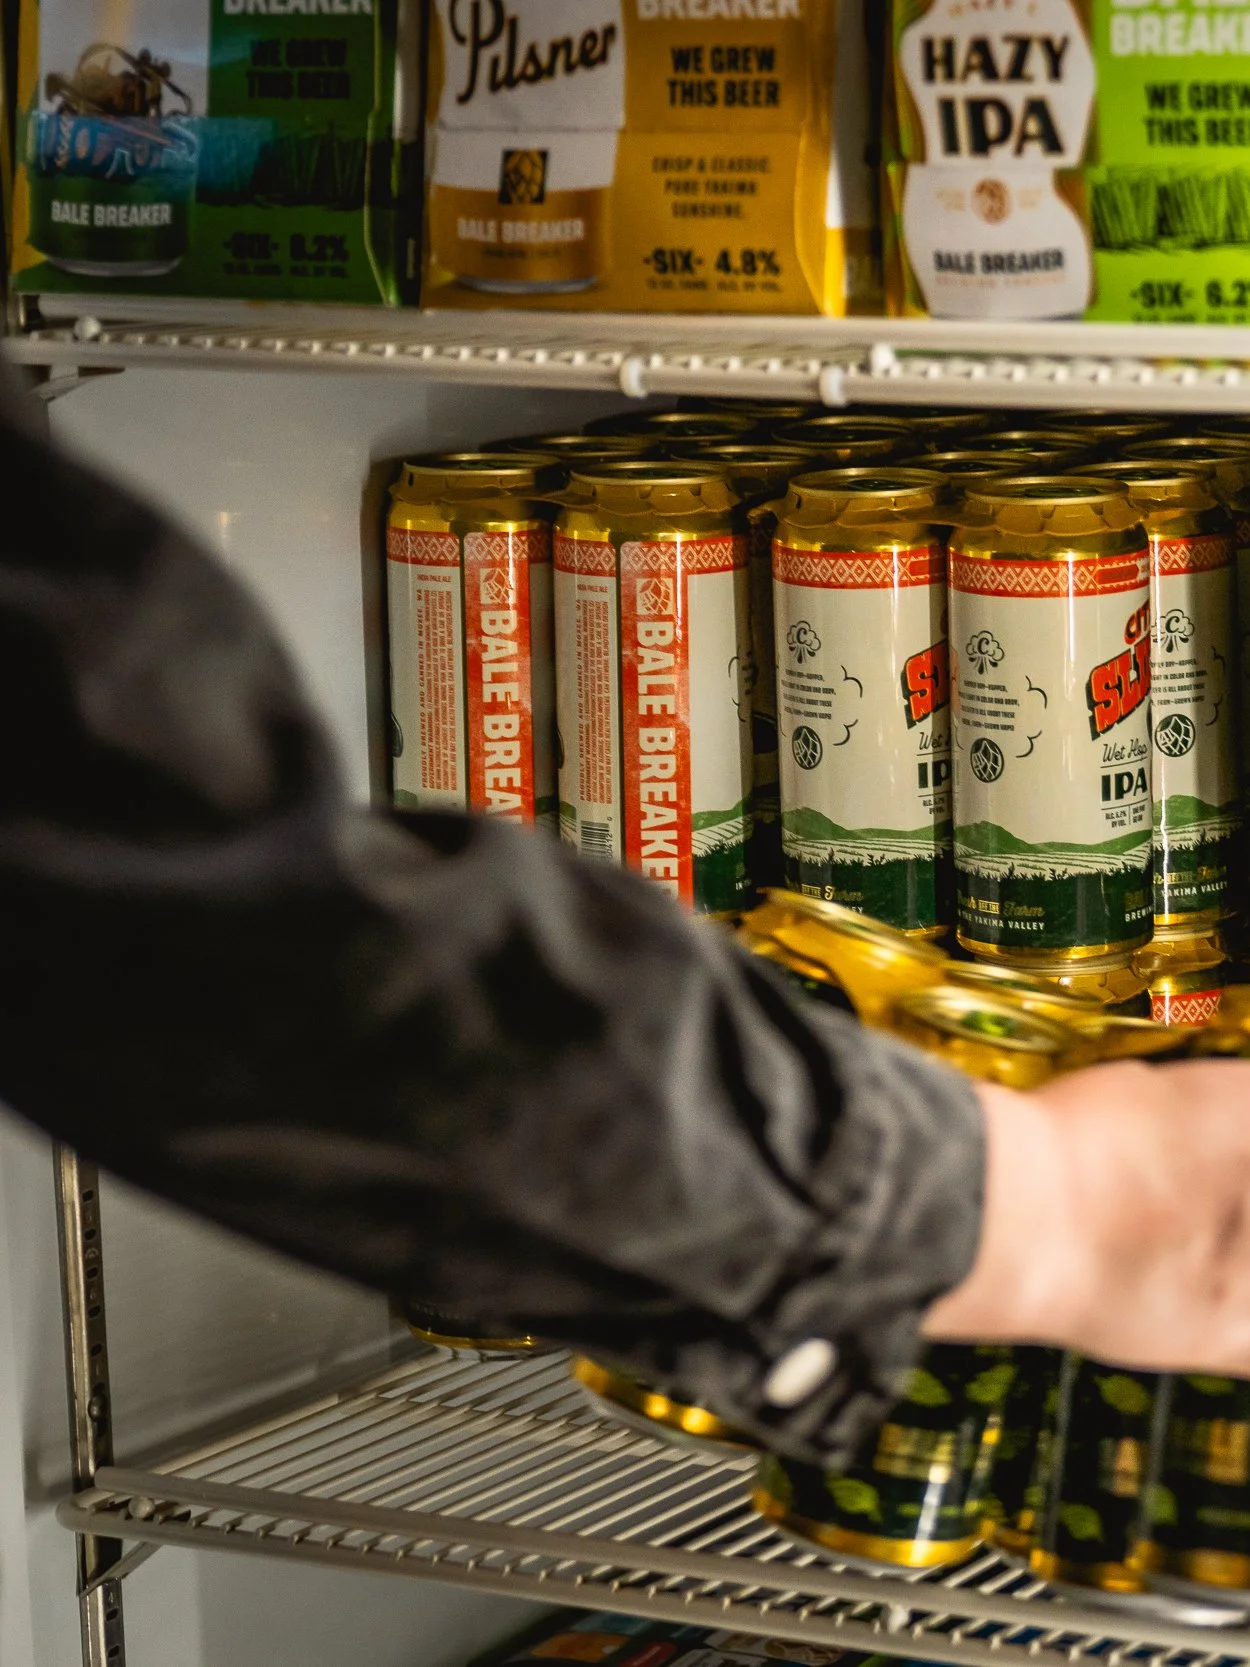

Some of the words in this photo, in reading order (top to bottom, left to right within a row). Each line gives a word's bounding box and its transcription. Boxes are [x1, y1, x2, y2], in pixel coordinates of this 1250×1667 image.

[671, 46, 703, 75] WE
[709, 45, 775, 75] GREW
[921, 35, 1069, 84] HAZY
[667, 79, 719, 109] THIS
[725, 79, 780, 108] BEER
[1145, 82, 1184, 110] WE
[938, 96, 1064, 156] IPA
[1143, 117, 1198, 147] THIS
[51, 200, 90, 224] BALE
[93, 202, 171, 228] BREAKER
[458, 218, 498, 243] BALE
[502, 218, 584, 243] BREAKER
[715, 248, 781, 276] 4.8%
[933, 249, 974, 274] BALE
[981, 248, 1064, 274] BREAKER
[480, 610, 519, 703] BALE
[636, 621, 676, 715] BALE
[1102, 742, 1126, 763] Wet
[1101, 767, 1148, 802] IPA
[974, 914, 1004, 929] YAKIMA
[1007, 919, 1045, 931] VALLEY
